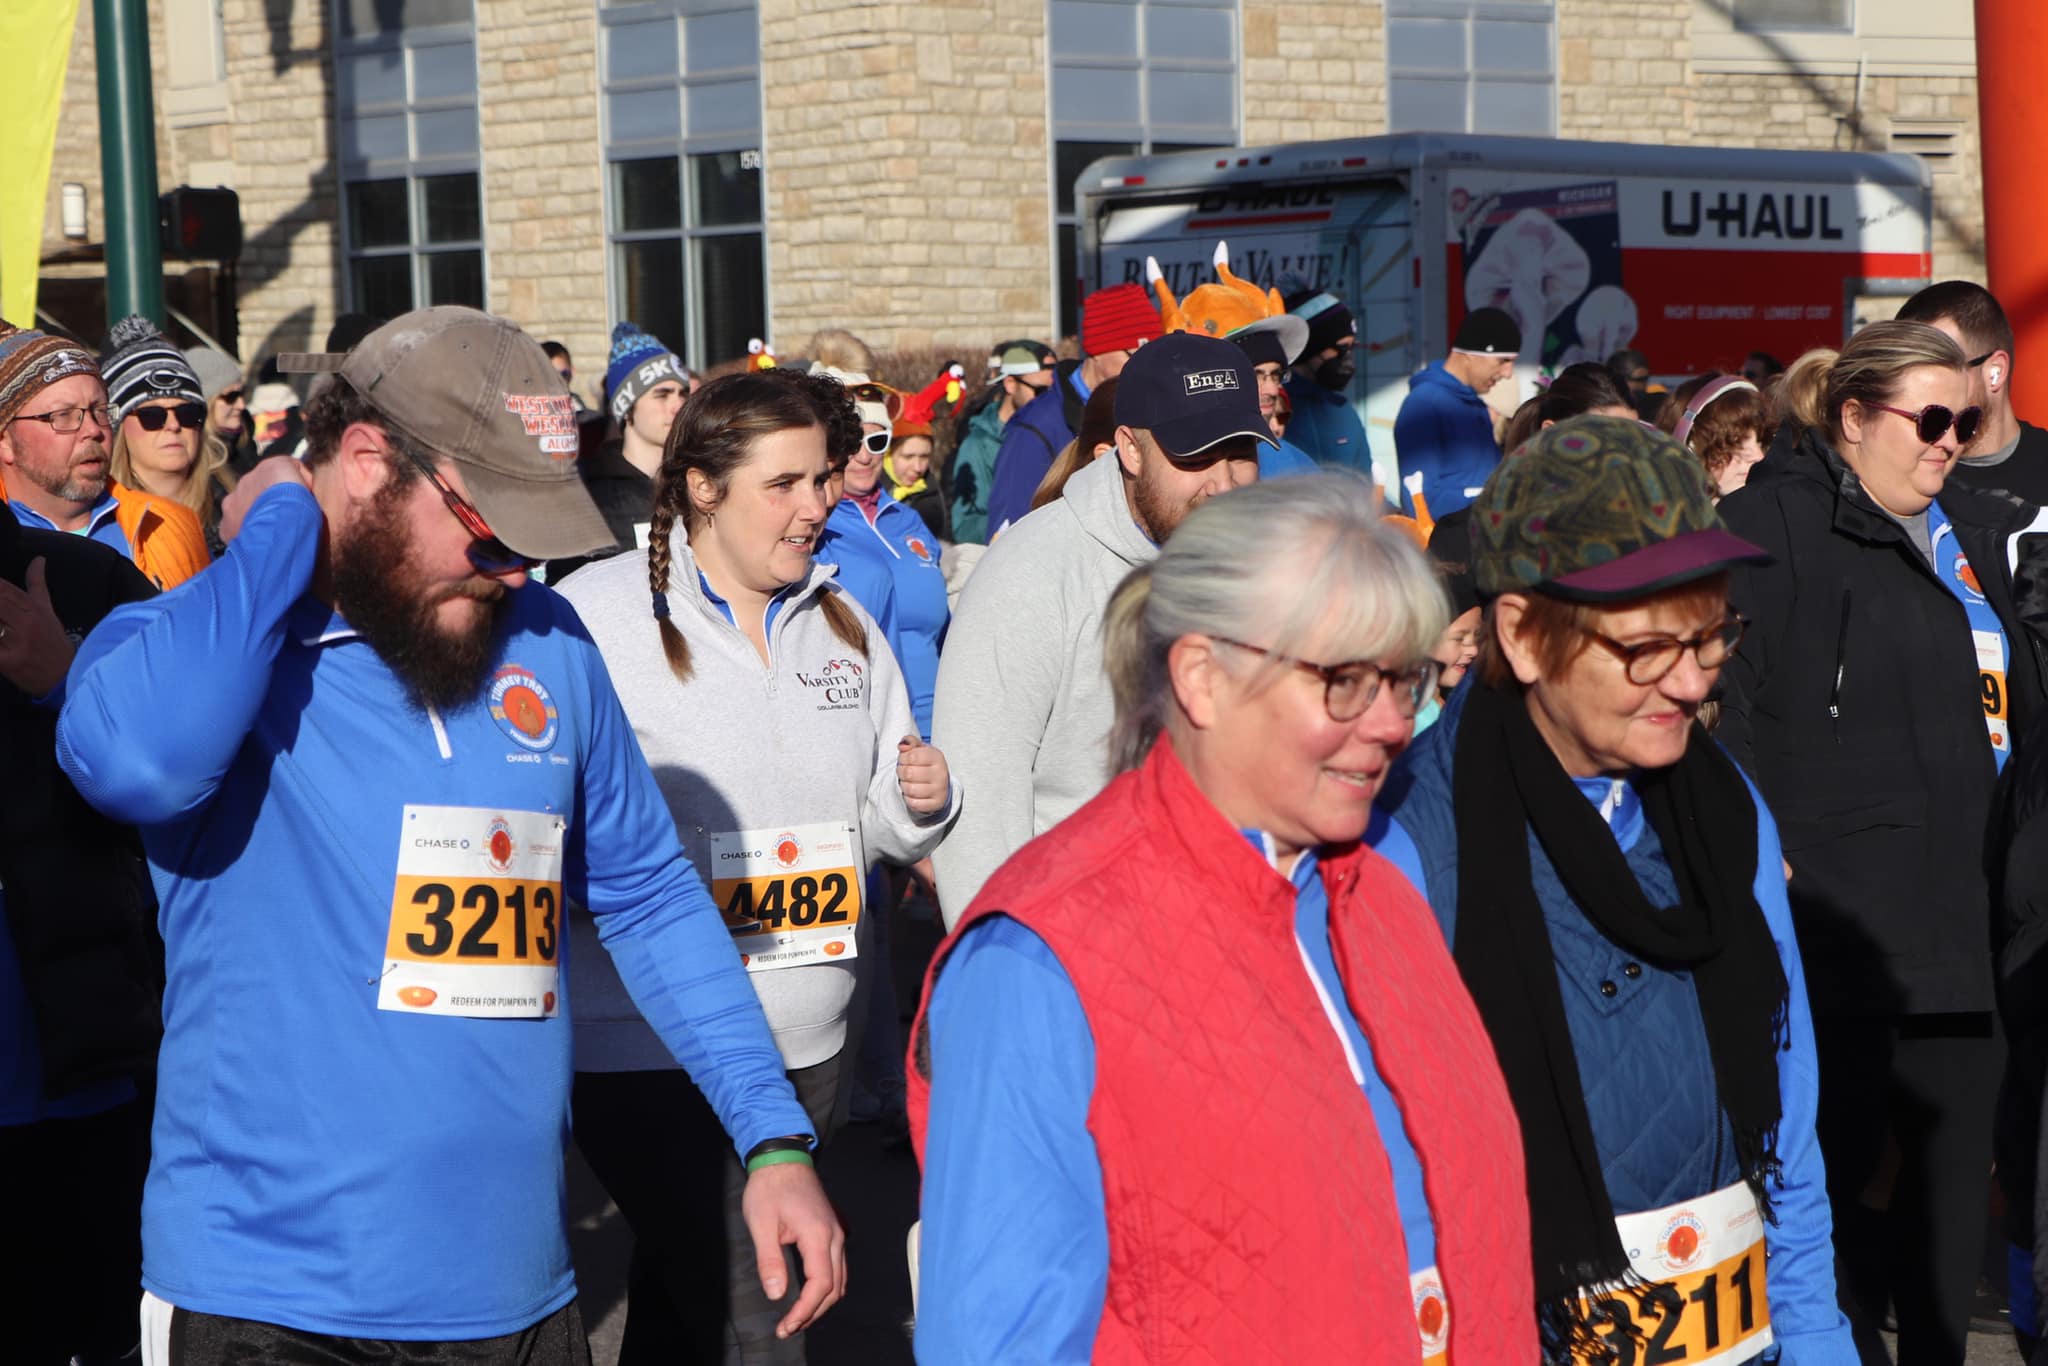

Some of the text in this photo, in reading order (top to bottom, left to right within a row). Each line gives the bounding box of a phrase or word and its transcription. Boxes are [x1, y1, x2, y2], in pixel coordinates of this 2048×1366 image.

[1662, 190, 1843, 239] U-HAUL
[639, 359, 672, 386] 5K
[415, 838, 458, 848] CHASE
[721, 851, 753, 861] CHASE
[728, 873, 848, 928] 4482
[406, 883, 556, 961] 3213
[450, 996, 481, 1008] REDEEM
[482, 997, 497, 1008] FOR
[498, 997, 528, 1008] PUMPKIN
